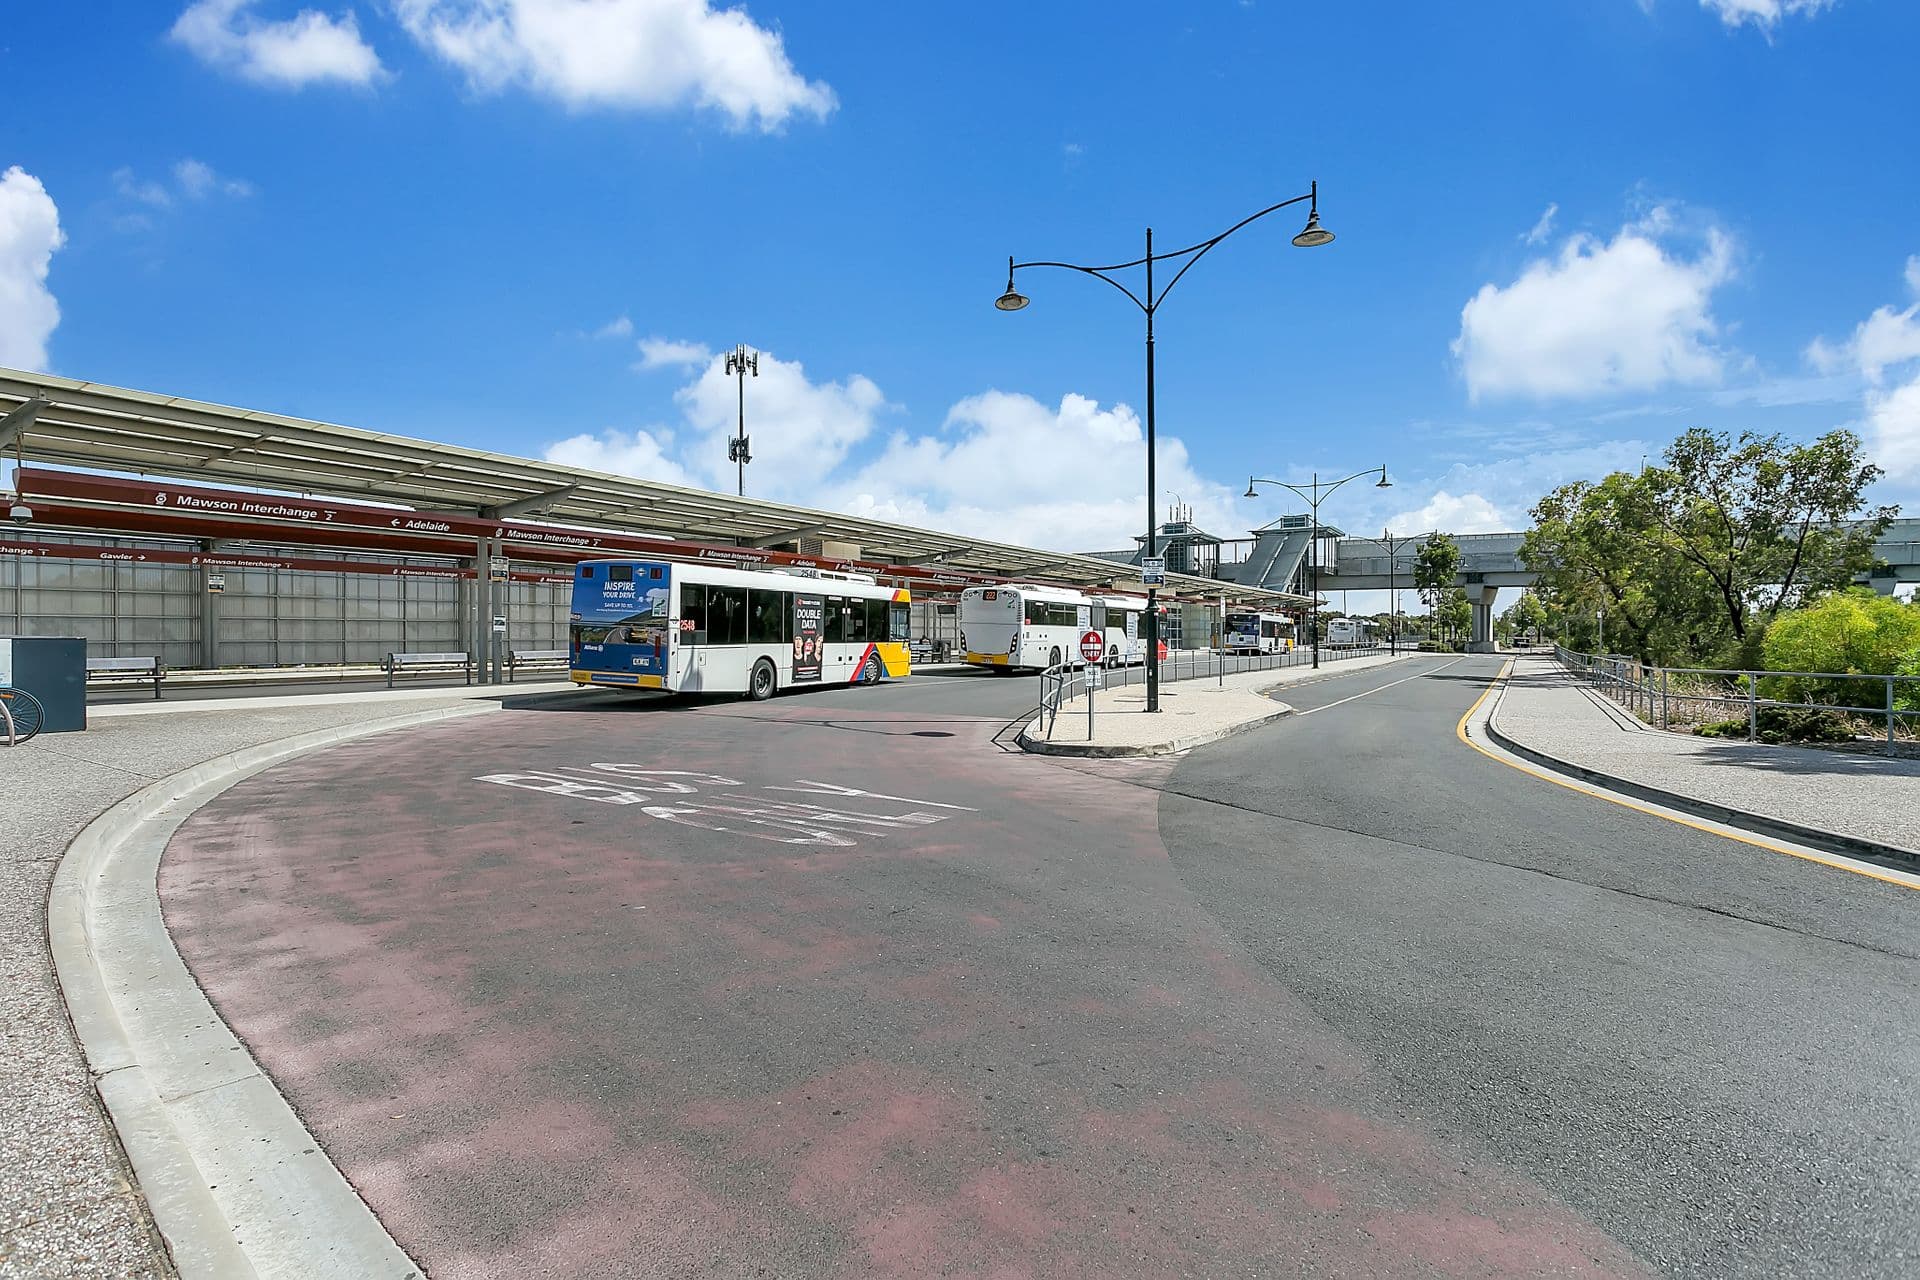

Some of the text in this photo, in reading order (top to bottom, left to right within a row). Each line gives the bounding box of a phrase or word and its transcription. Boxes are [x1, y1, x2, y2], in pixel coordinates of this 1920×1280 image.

[176, 494, 333, 521] Mawson Interchange 2
[405, 519, 451, 532] Adelaide
[506, 529, 543, 541] Mawson
[544, 534, 590, 546] Interchange
[100, 552, 133, 560] Gawler
[706, 550, 731, 559] Mawson
[731, 552, 762, 563] Interchange
[202, 558, 236, 566] Mawson
[237, 560, 282, 568] Interchange
[604, 581, 637, 592] INSPIRE
[602, 591, 618, 599] YOUR
[796, 608, 821, 619] DOUBLE
[802, 620, 817, 629] DATA
[472, 763, 745, 805] BUS
[640, 779, 980, 847] ONLY
